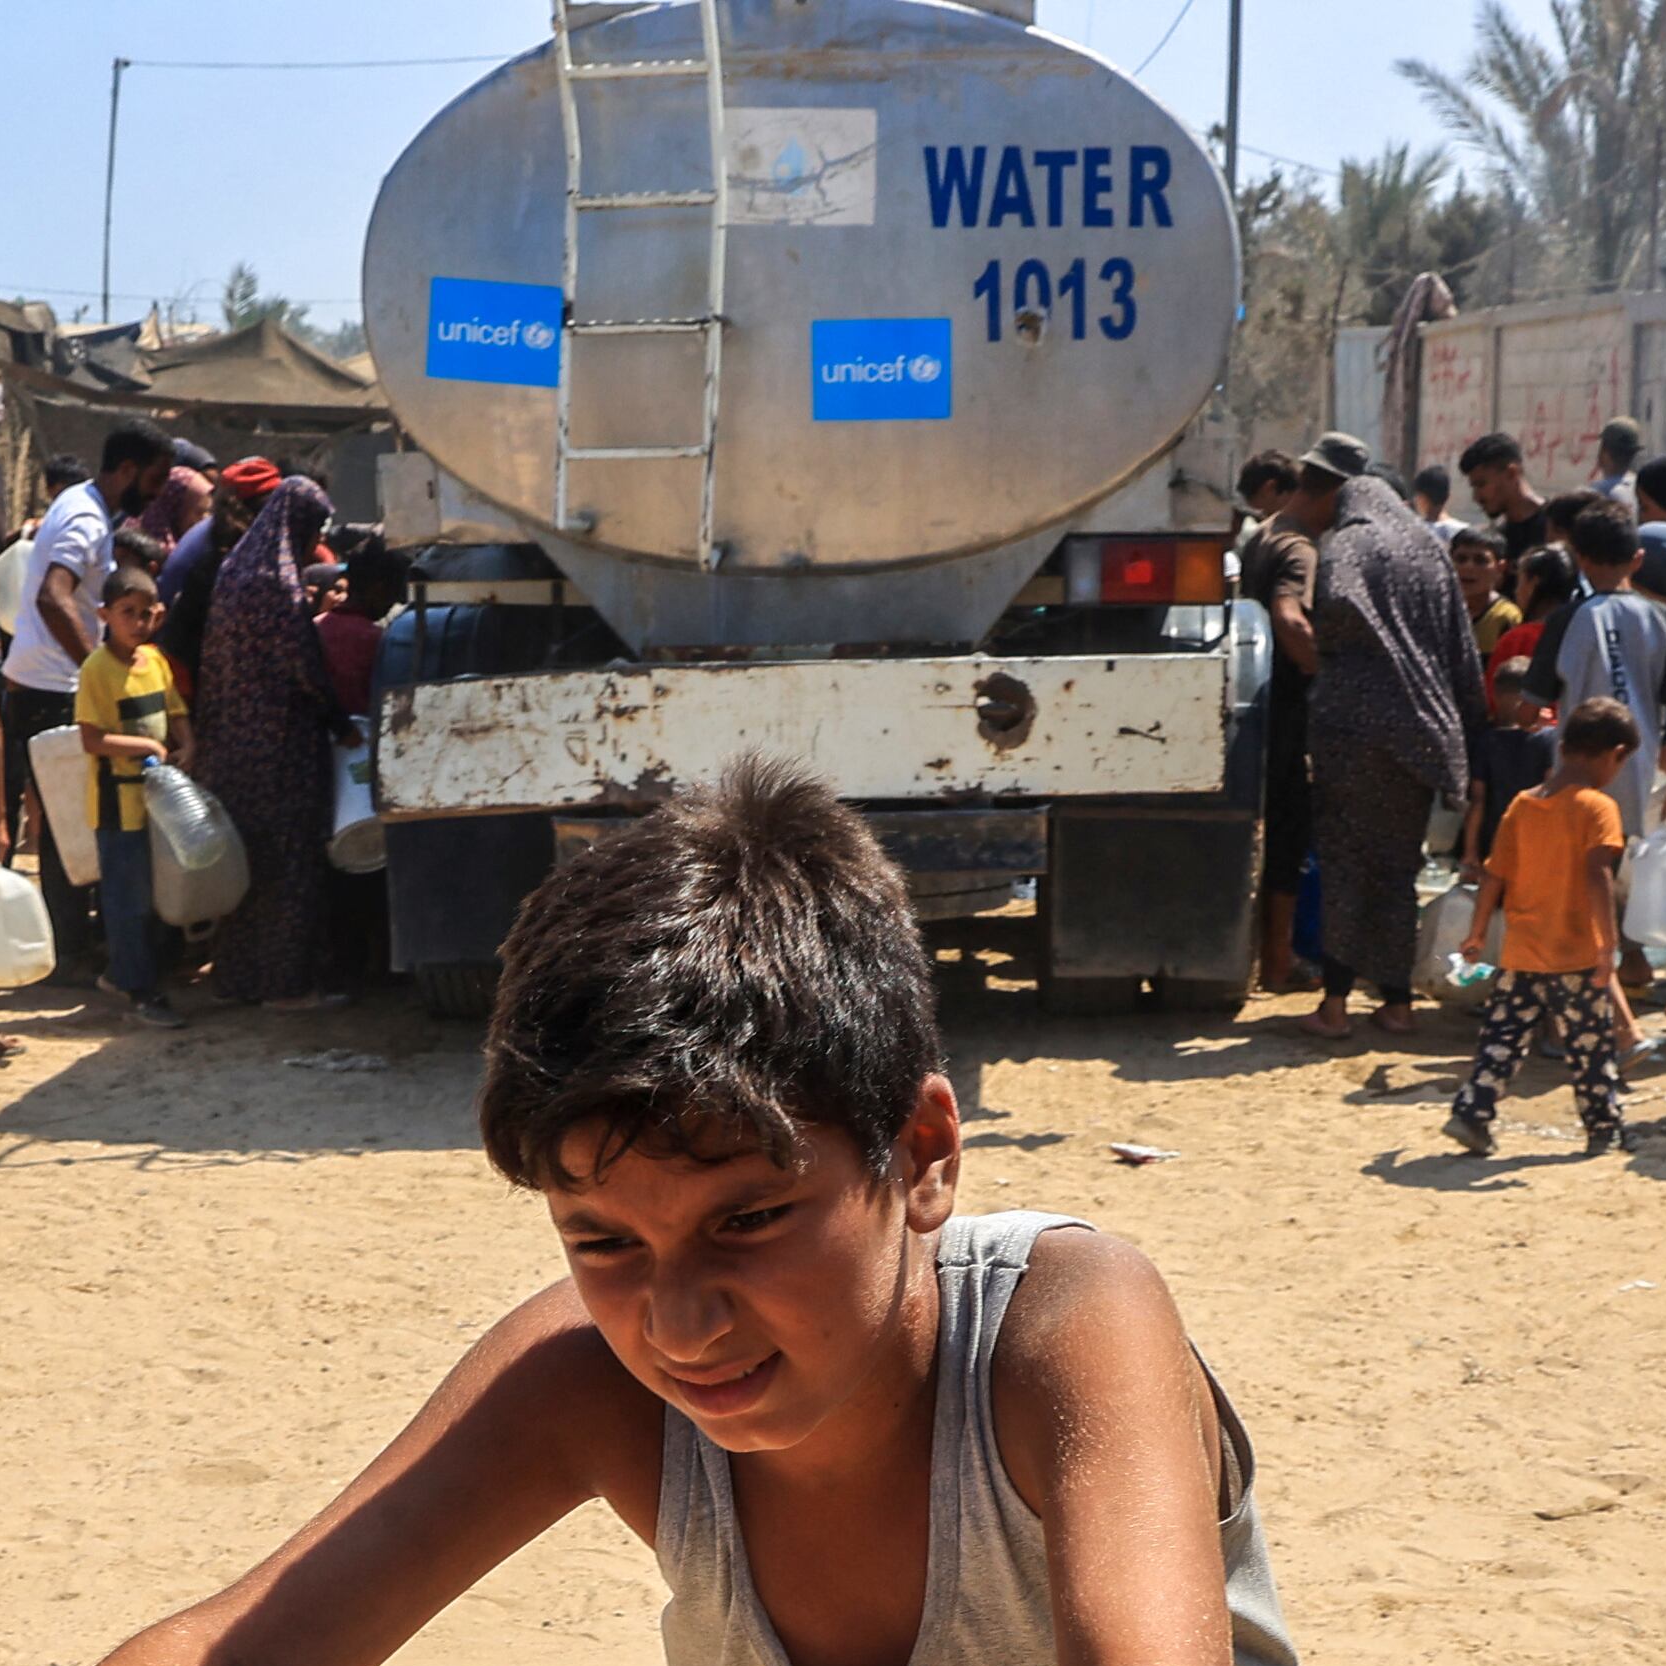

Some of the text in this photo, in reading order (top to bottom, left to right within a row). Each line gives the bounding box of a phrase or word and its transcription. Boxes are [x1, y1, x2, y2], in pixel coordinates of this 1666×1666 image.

[923, 145, 1174, 228] WATER
[973, 257, 1137, 342] 1013
[437, 316, 521, 346] unicef
[821, 354, 906, 383] unicef
